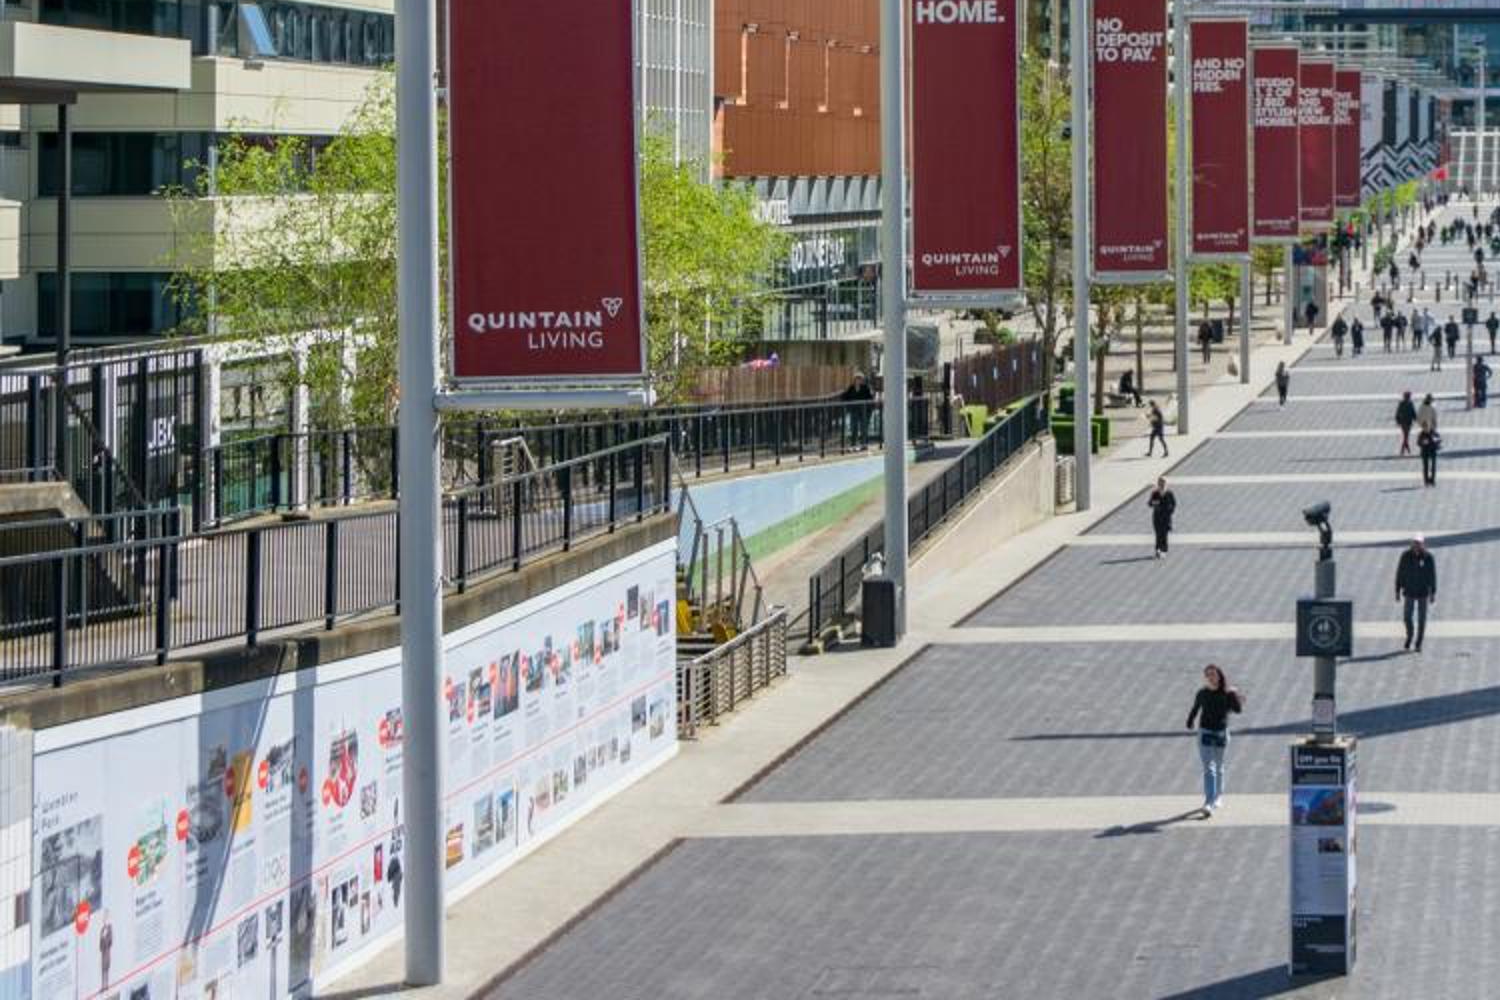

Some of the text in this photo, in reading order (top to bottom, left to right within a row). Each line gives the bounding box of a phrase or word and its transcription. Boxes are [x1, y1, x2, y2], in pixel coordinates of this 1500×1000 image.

[916, 0, 1005, 24] HOME.
[1096, 17, 1123, 32] NO
[1096, 32, 1164, 47] DEPOSIT
[1096, 48, 1156, 62] TO PAY.
[1194, 58, 1244, 69] AND NO
[1194, 70, 1241, 81] HIDDEN
[1100, 245, 1154, 255] QUINTAIN
[921, 253, 999, 265] QUINTAIN
[955, 264, 999, 276] LIVING
[468, 310, 603, 332] QUINTAIN
[528, 332, 604, 350] LIVING
